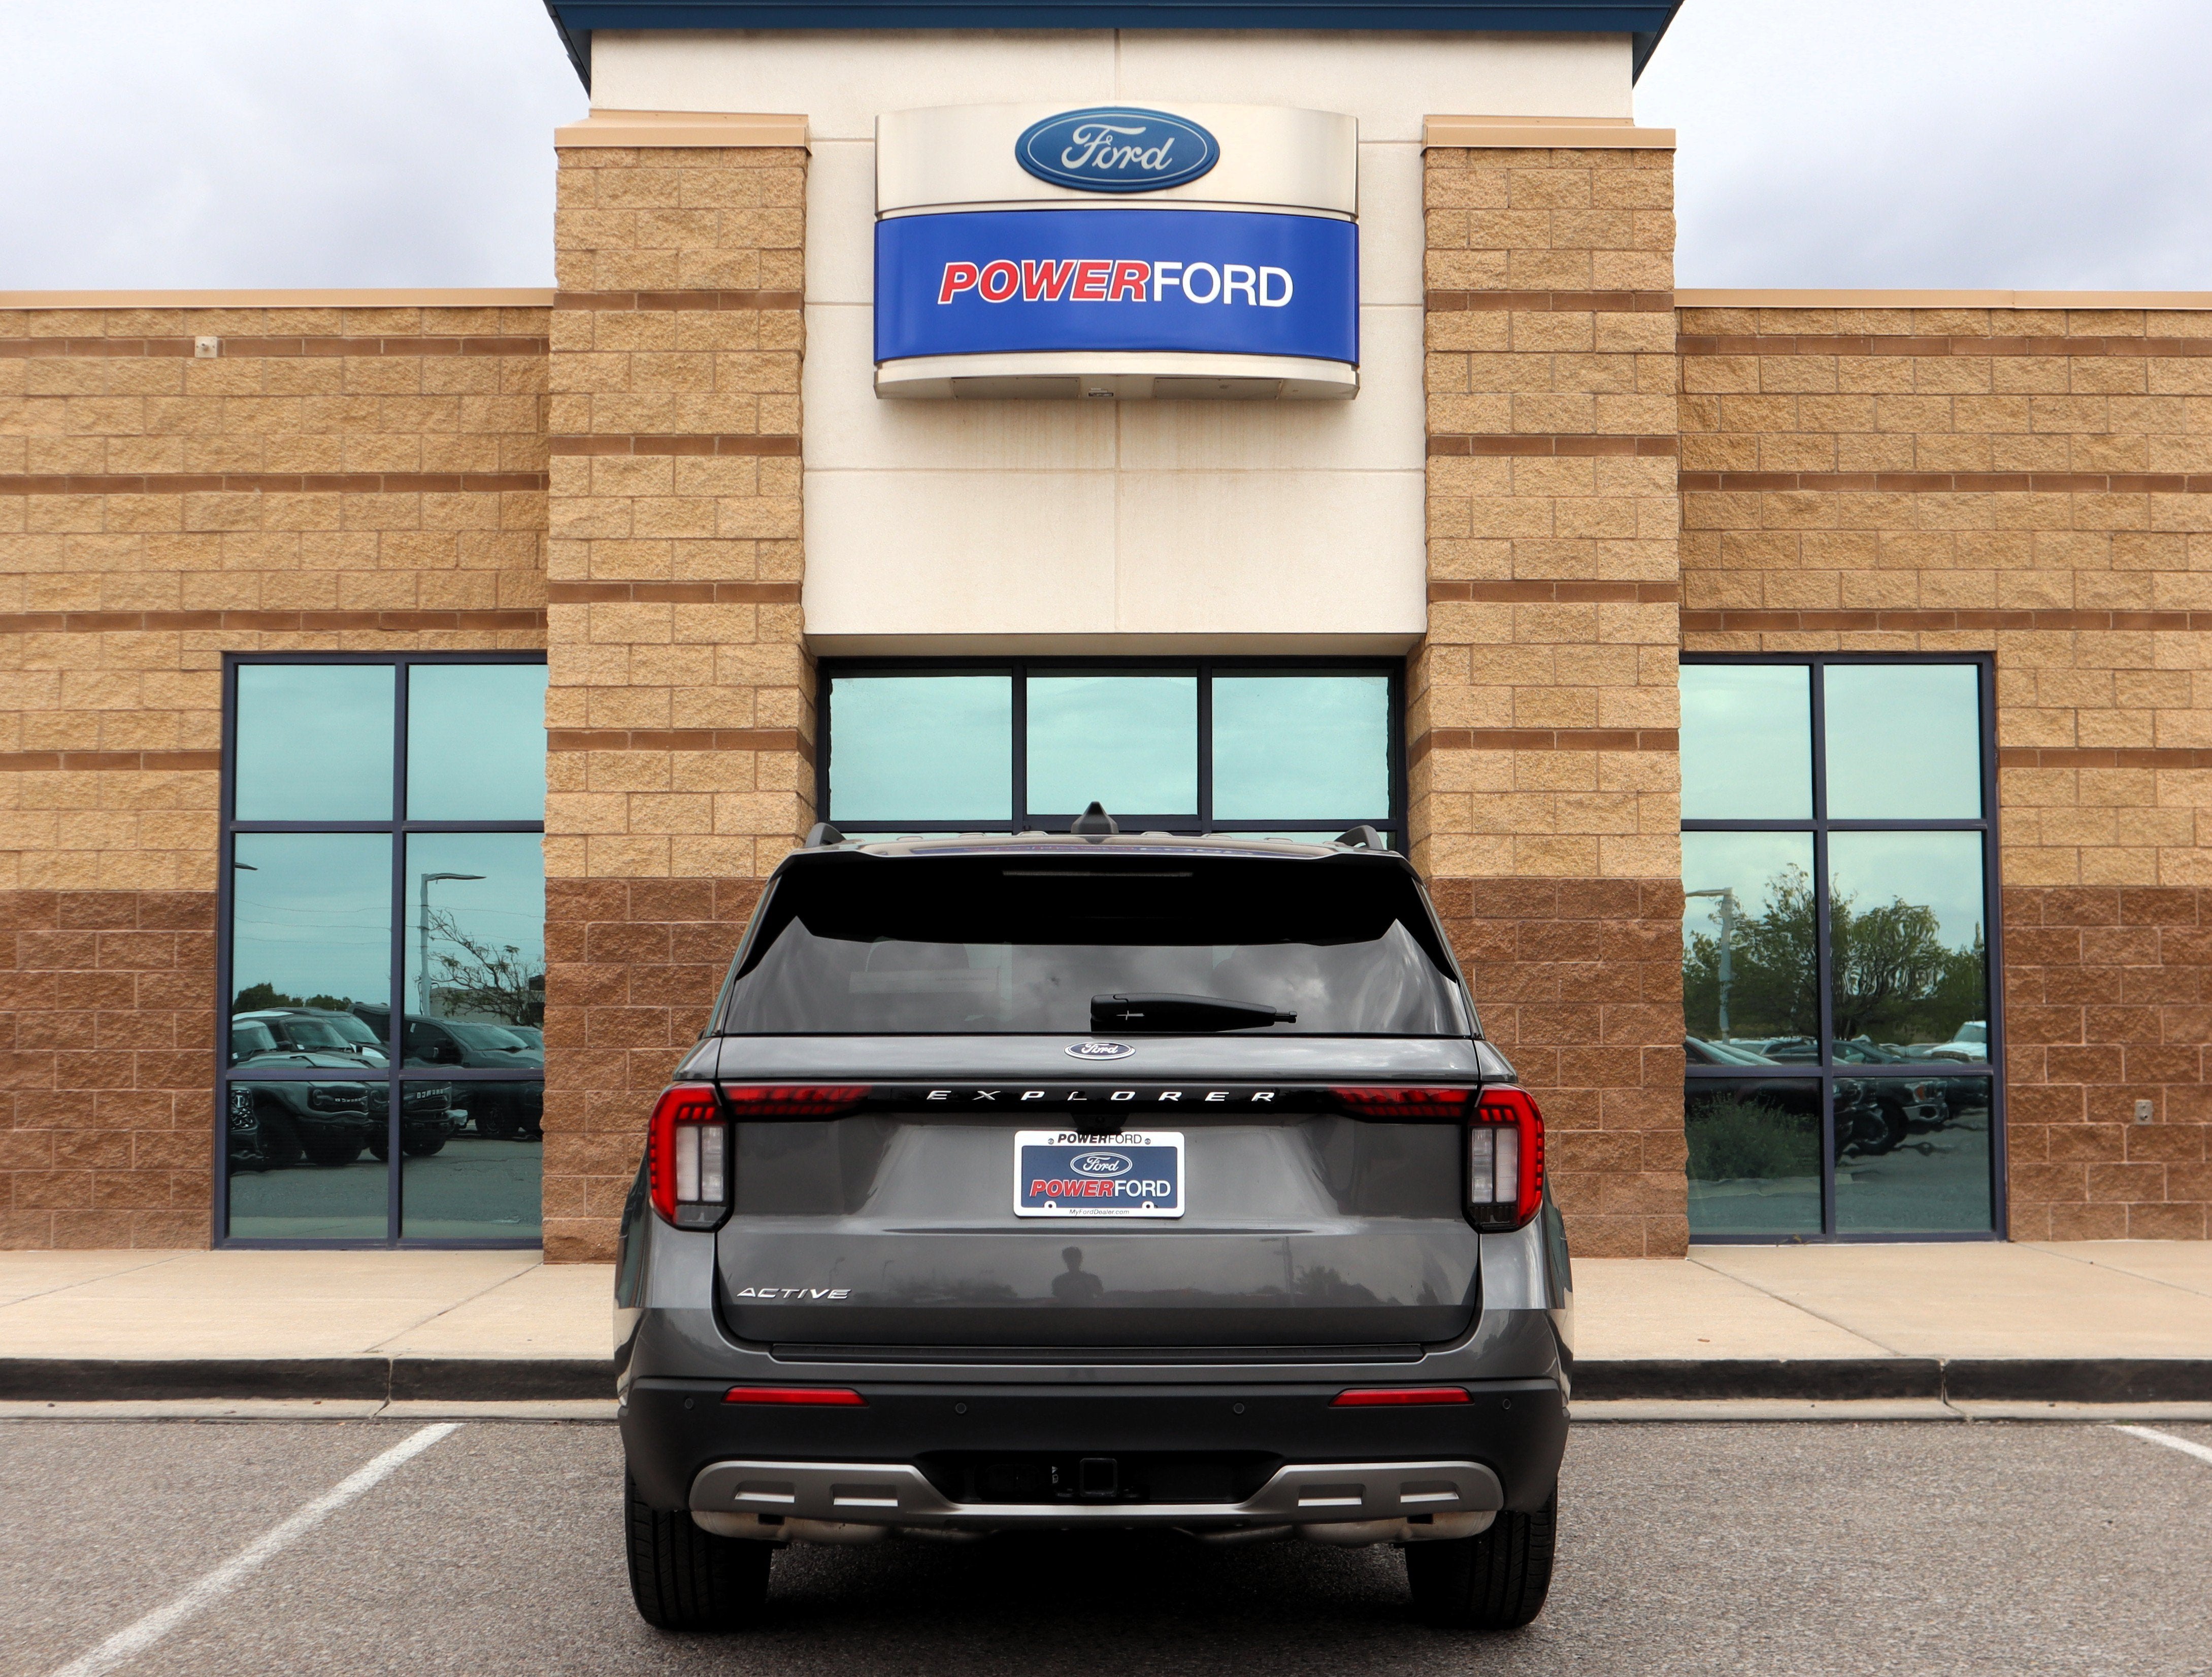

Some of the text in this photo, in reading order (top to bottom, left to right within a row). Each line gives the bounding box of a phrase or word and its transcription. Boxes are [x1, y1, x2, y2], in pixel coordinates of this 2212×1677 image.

[1061, 123, 1175, 171] Ford
[1081, 1043, 1118, 1054] Ford
[927, 1090, 1275, 1101] EXPLORER
[1082, 1156, 1120, 1172] Ford
[1069, 1209, 1130, 1217] MyFordDealer.com
[737, 1287, 851, 1299] ACTIVE
